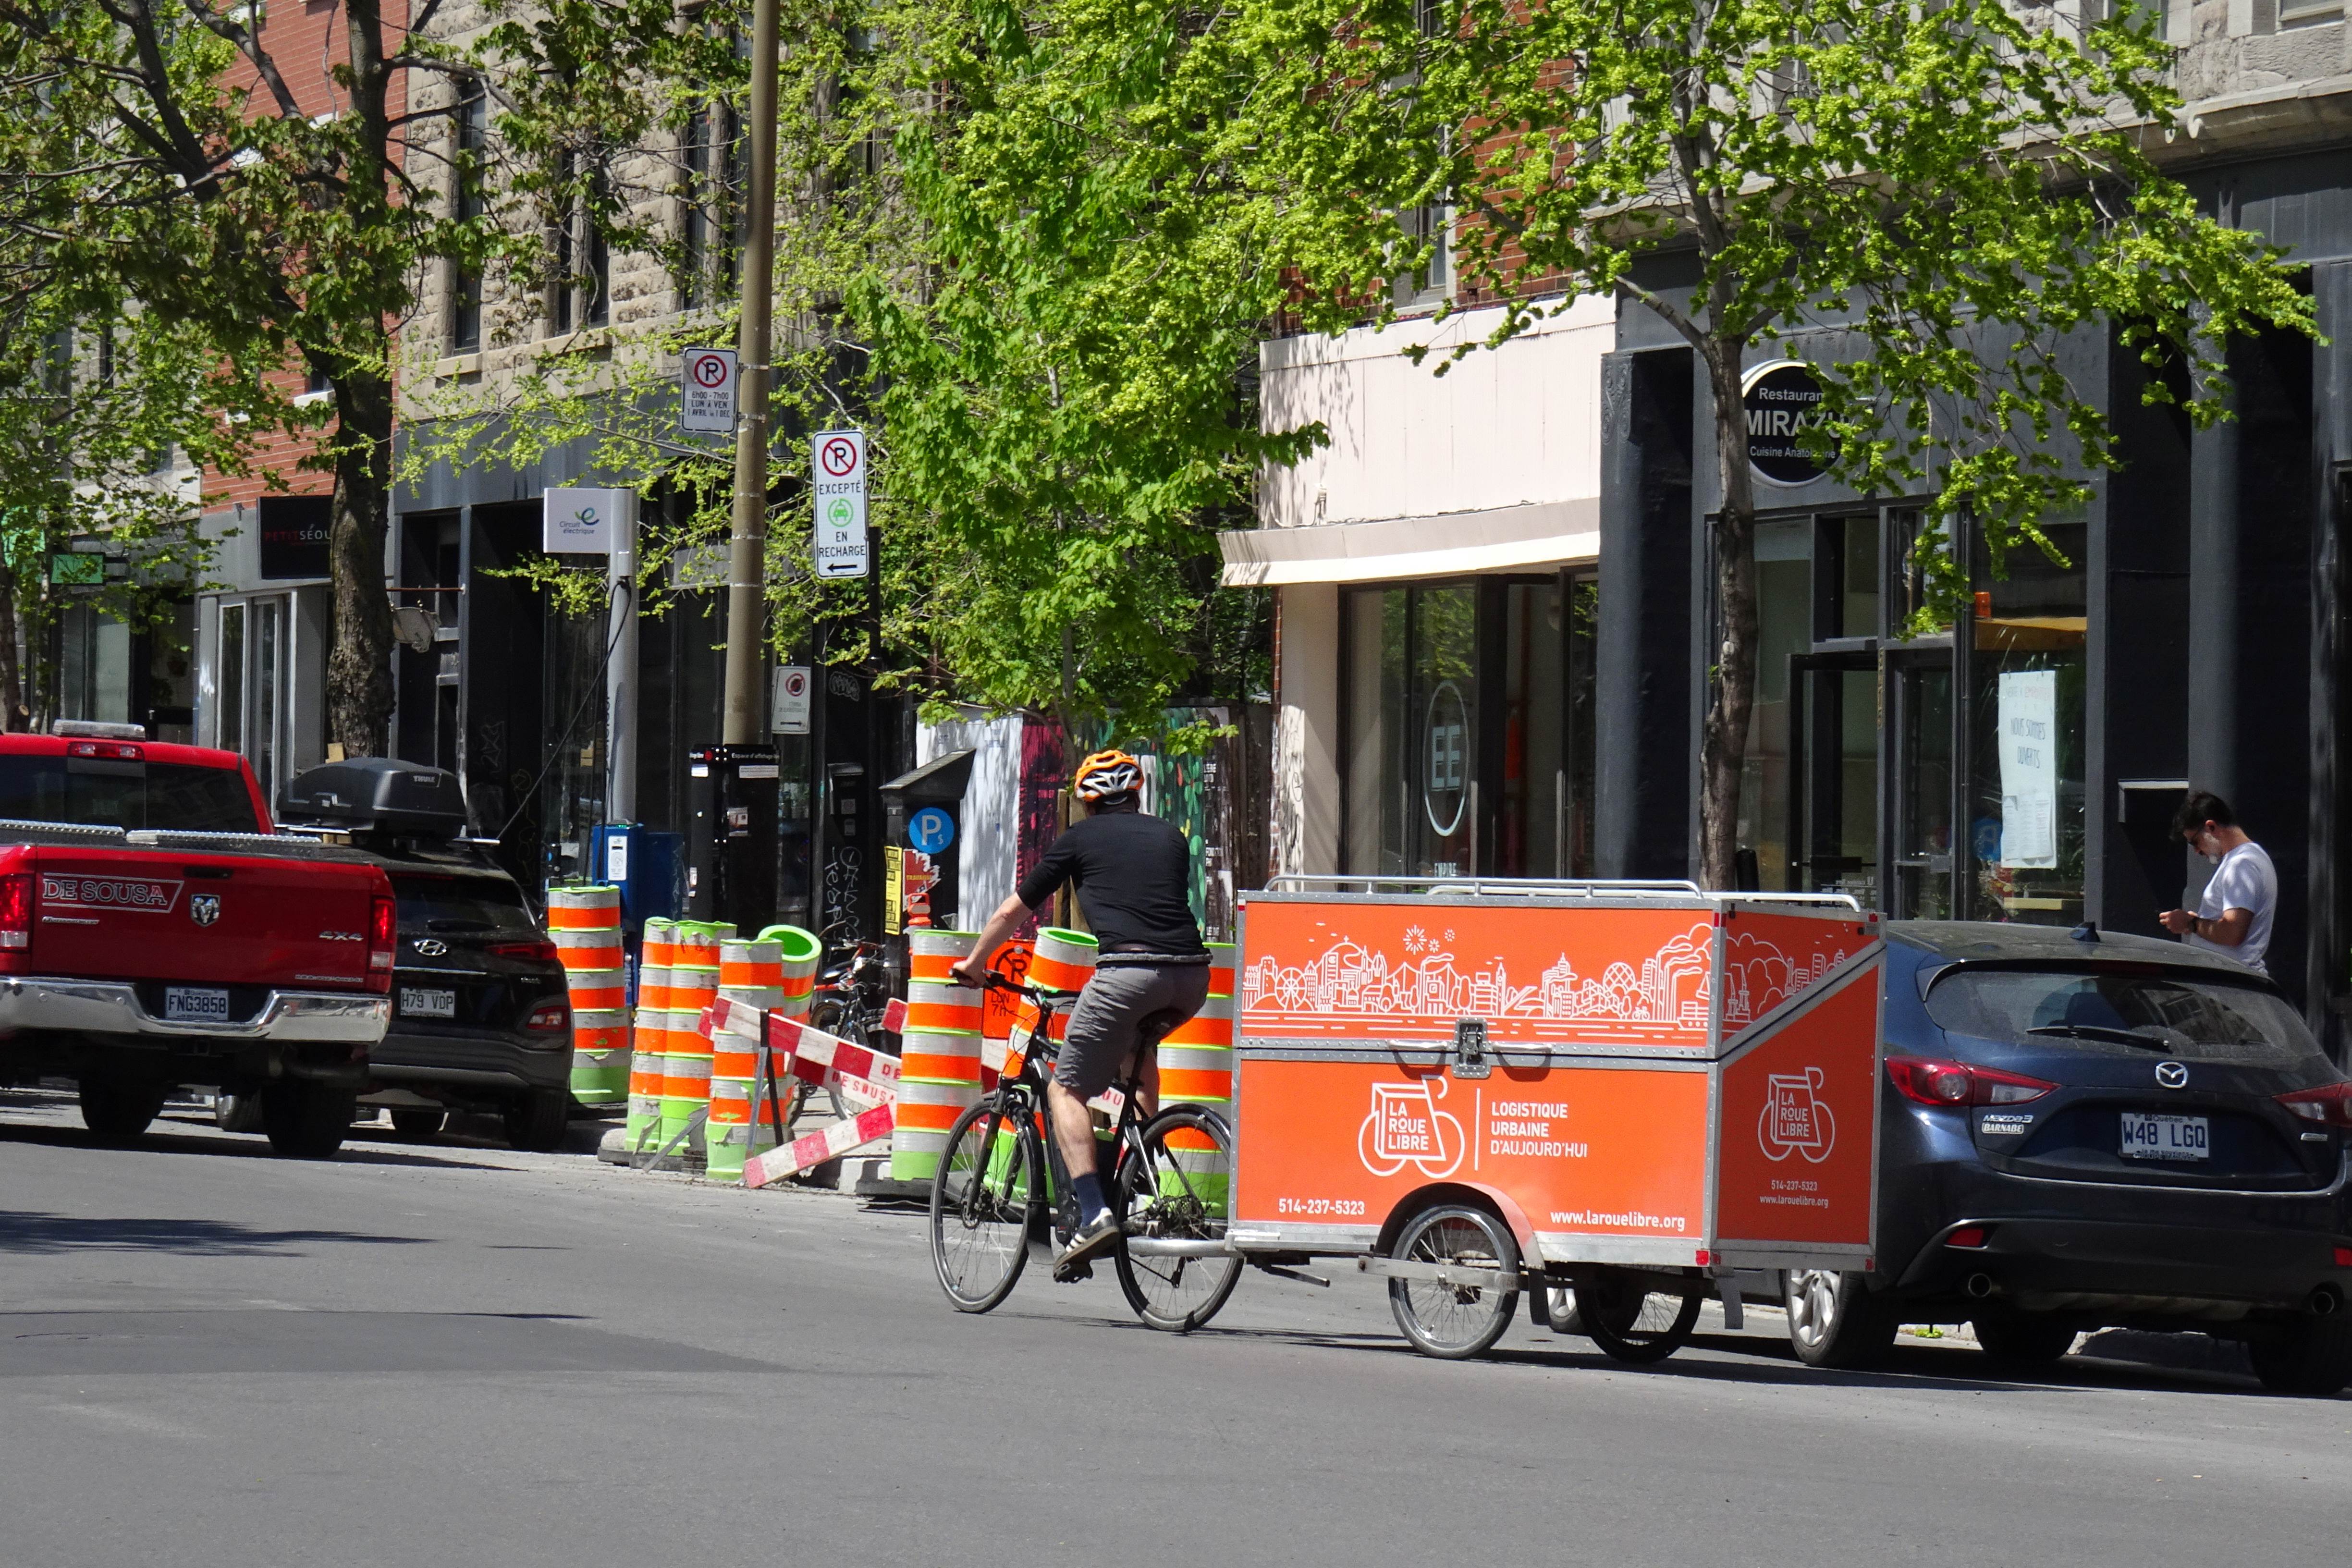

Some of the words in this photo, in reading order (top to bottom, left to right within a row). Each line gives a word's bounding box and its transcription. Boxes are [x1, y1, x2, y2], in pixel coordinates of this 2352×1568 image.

[713, 392, 729, 400] 7h00
[1759, 388, 1824, 401] Restauran
[1750, 446, 1782, 456] Cuisine
[819, 480, 861, 495] EXCEPTÉ
[836, 532, 847, 542] EN
[819, 545, 865, 557] RECHARGE
[921, 815, 942, 845] P
[43, 879, 77, 900] DE
[82, 881, 167, 906] SOUSA
[169, 995, 226, 1013] FNG3858
[402, 993, 425, 1008] H79
[1781, 1092, 1794, 1105] LA
[1390, 1102, 1408, 1116] LA
[1491, 1102, 1568, 1119] LOGISTIQUE
[1781, 1107, 1808, 1122] ROUE
[1389, 1117, 1426, 1134] ROUE
[2153, 1114, 2183, 1123] Québec
[1491, 1122, 1550, 1138] URBAINE
[1780, 1122, 1810, 1137] LIBRE
[1984, 1124, 2022, 1132] BARNABE
[2123, 1122, 2158, 1145] W48
[2170, 1124, 2206, 1148] LGQ
[1388, 1135, 1429, 1151] LIBRE
[1491, 1140, 1588, 1158] D'AUJOURD'HUI
[1771, 1179, 1817, 1191] 514-237-5323
[1278, 1198, 1365, 1215] 514-237-5323
[1760, 1195, 1828, 1209] www.larouelibre.org
[1550, 1210, 1685, 1232] www.larouelibre.org
